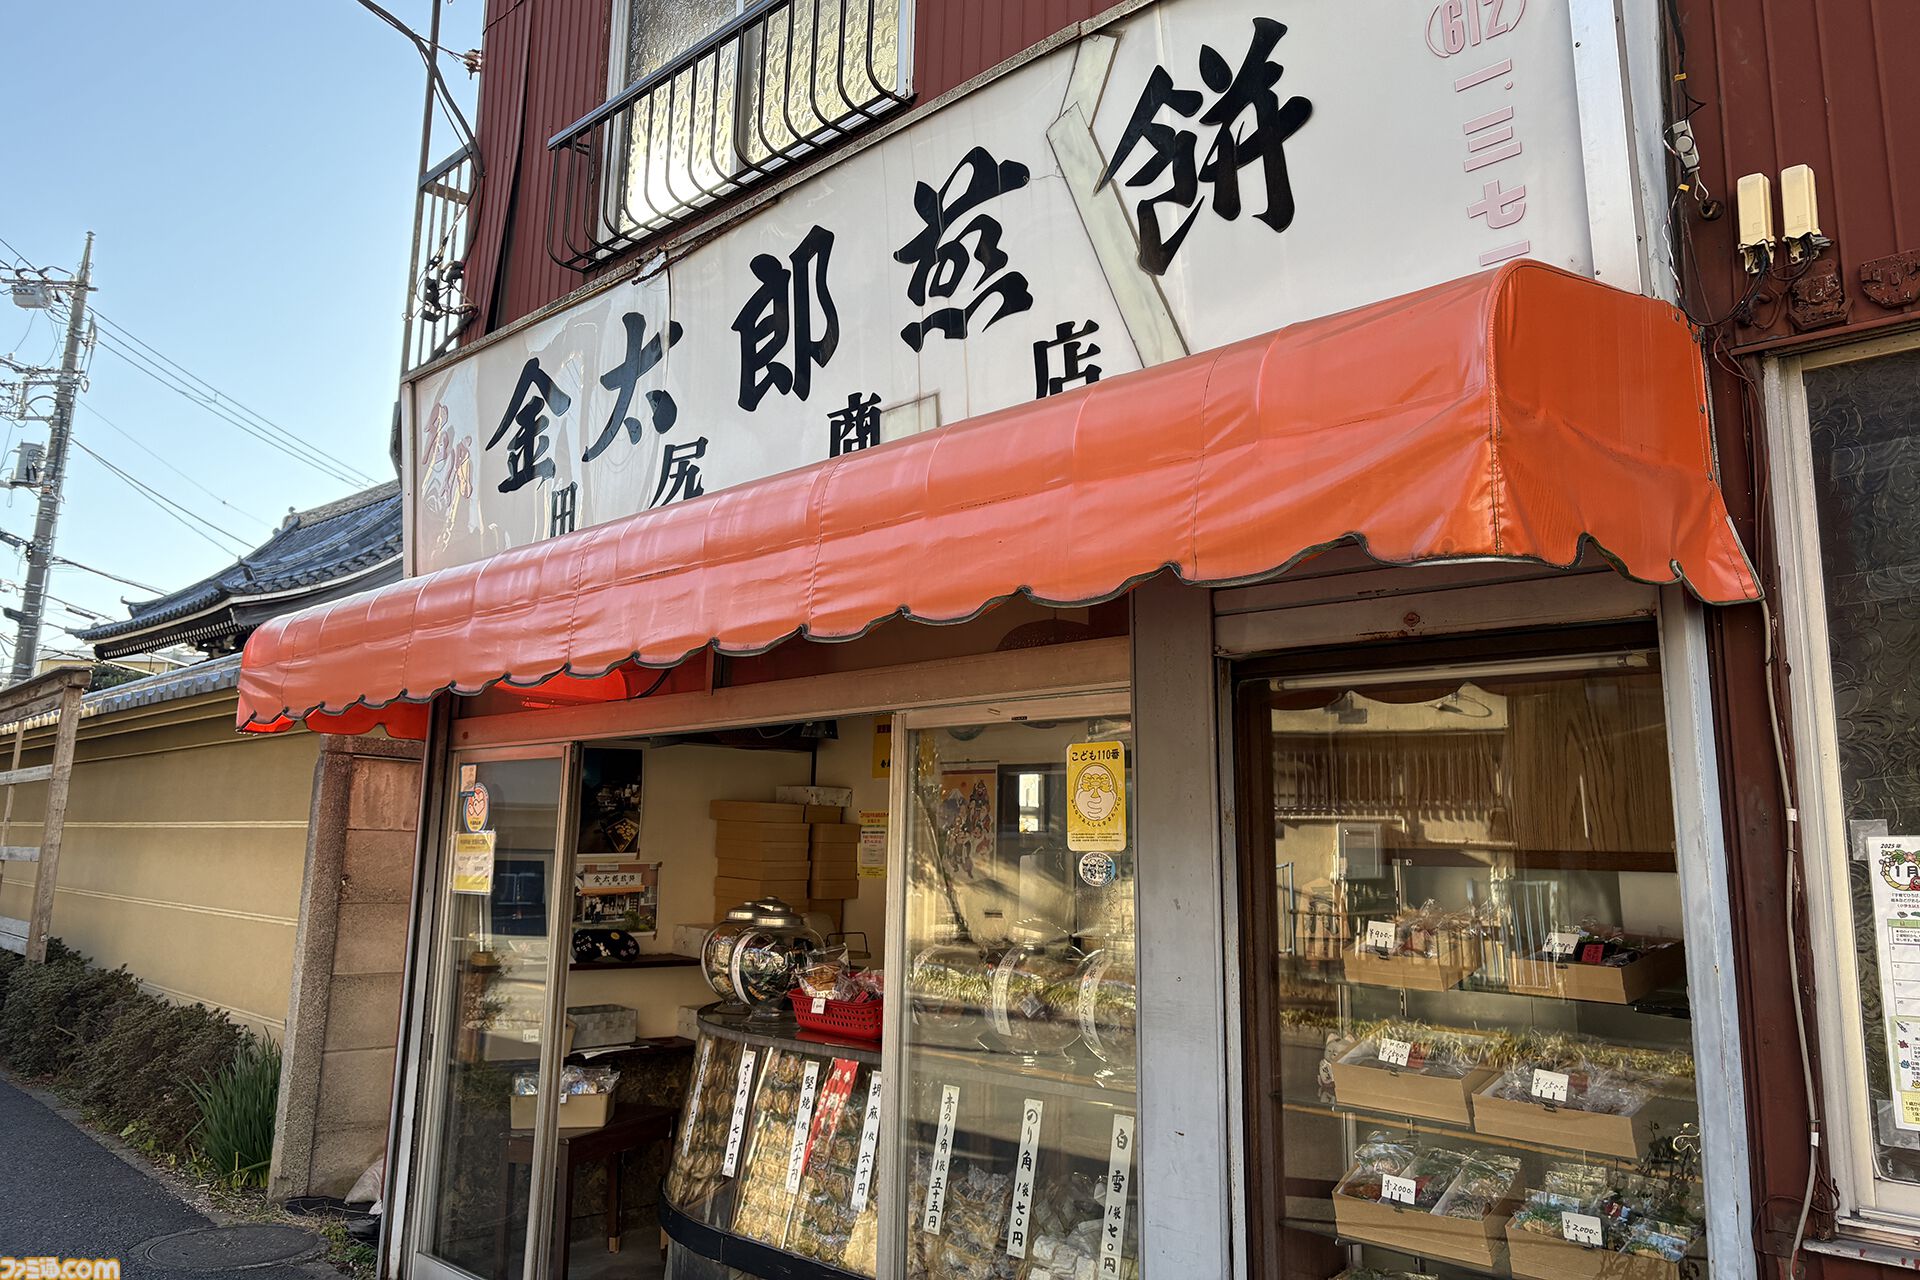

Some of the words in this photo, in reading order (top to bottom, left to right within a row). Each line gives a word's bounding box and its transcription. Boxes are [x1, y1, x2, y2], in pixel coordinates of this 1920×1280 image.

[485, 17, 1313, 493] 金太郎煎餅
[551, 319, 1102, 537] 田尻商店
[1071, 748, 1120, 761] こども110番
[1895, 865, 1919, 878] 1月
